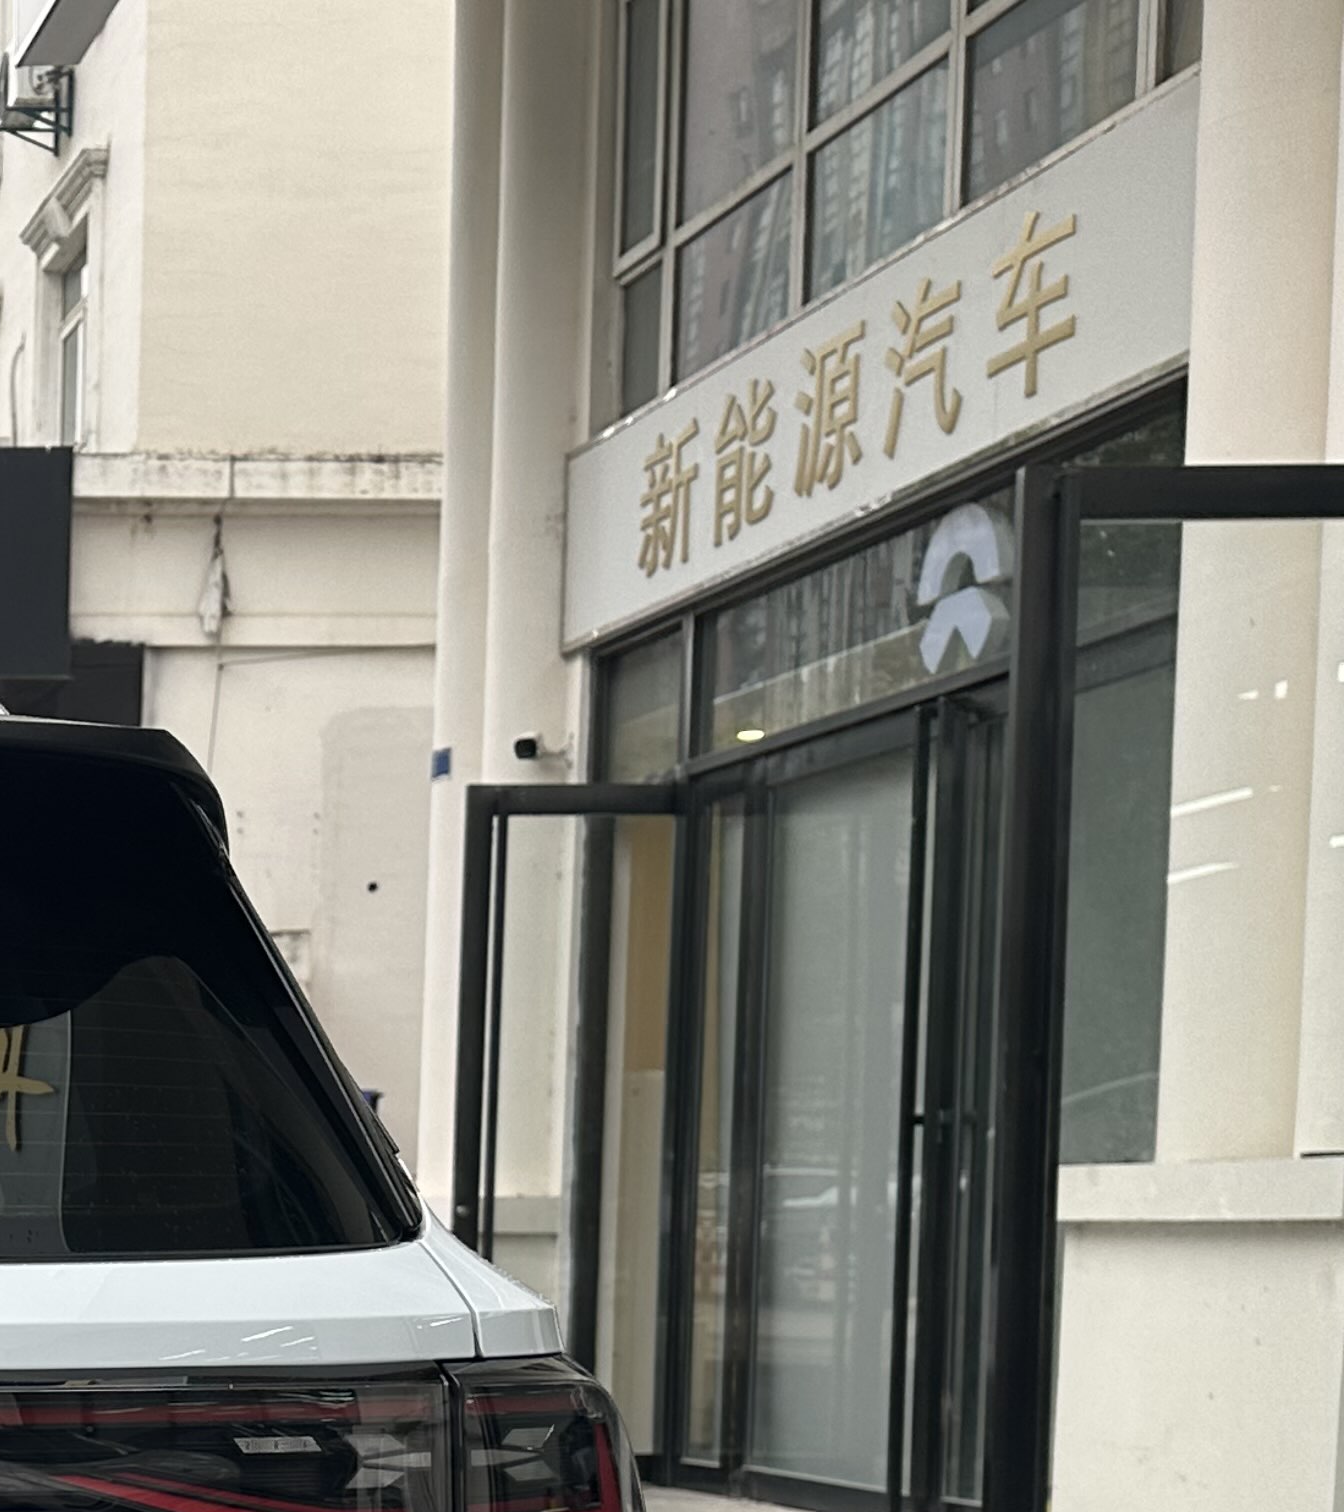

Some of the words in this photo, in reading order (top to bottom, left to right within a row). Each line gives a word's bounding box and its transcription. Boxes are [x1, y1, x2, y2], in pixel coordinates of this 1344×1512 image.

[636, 210, 1078, 579] 新能源汽车
